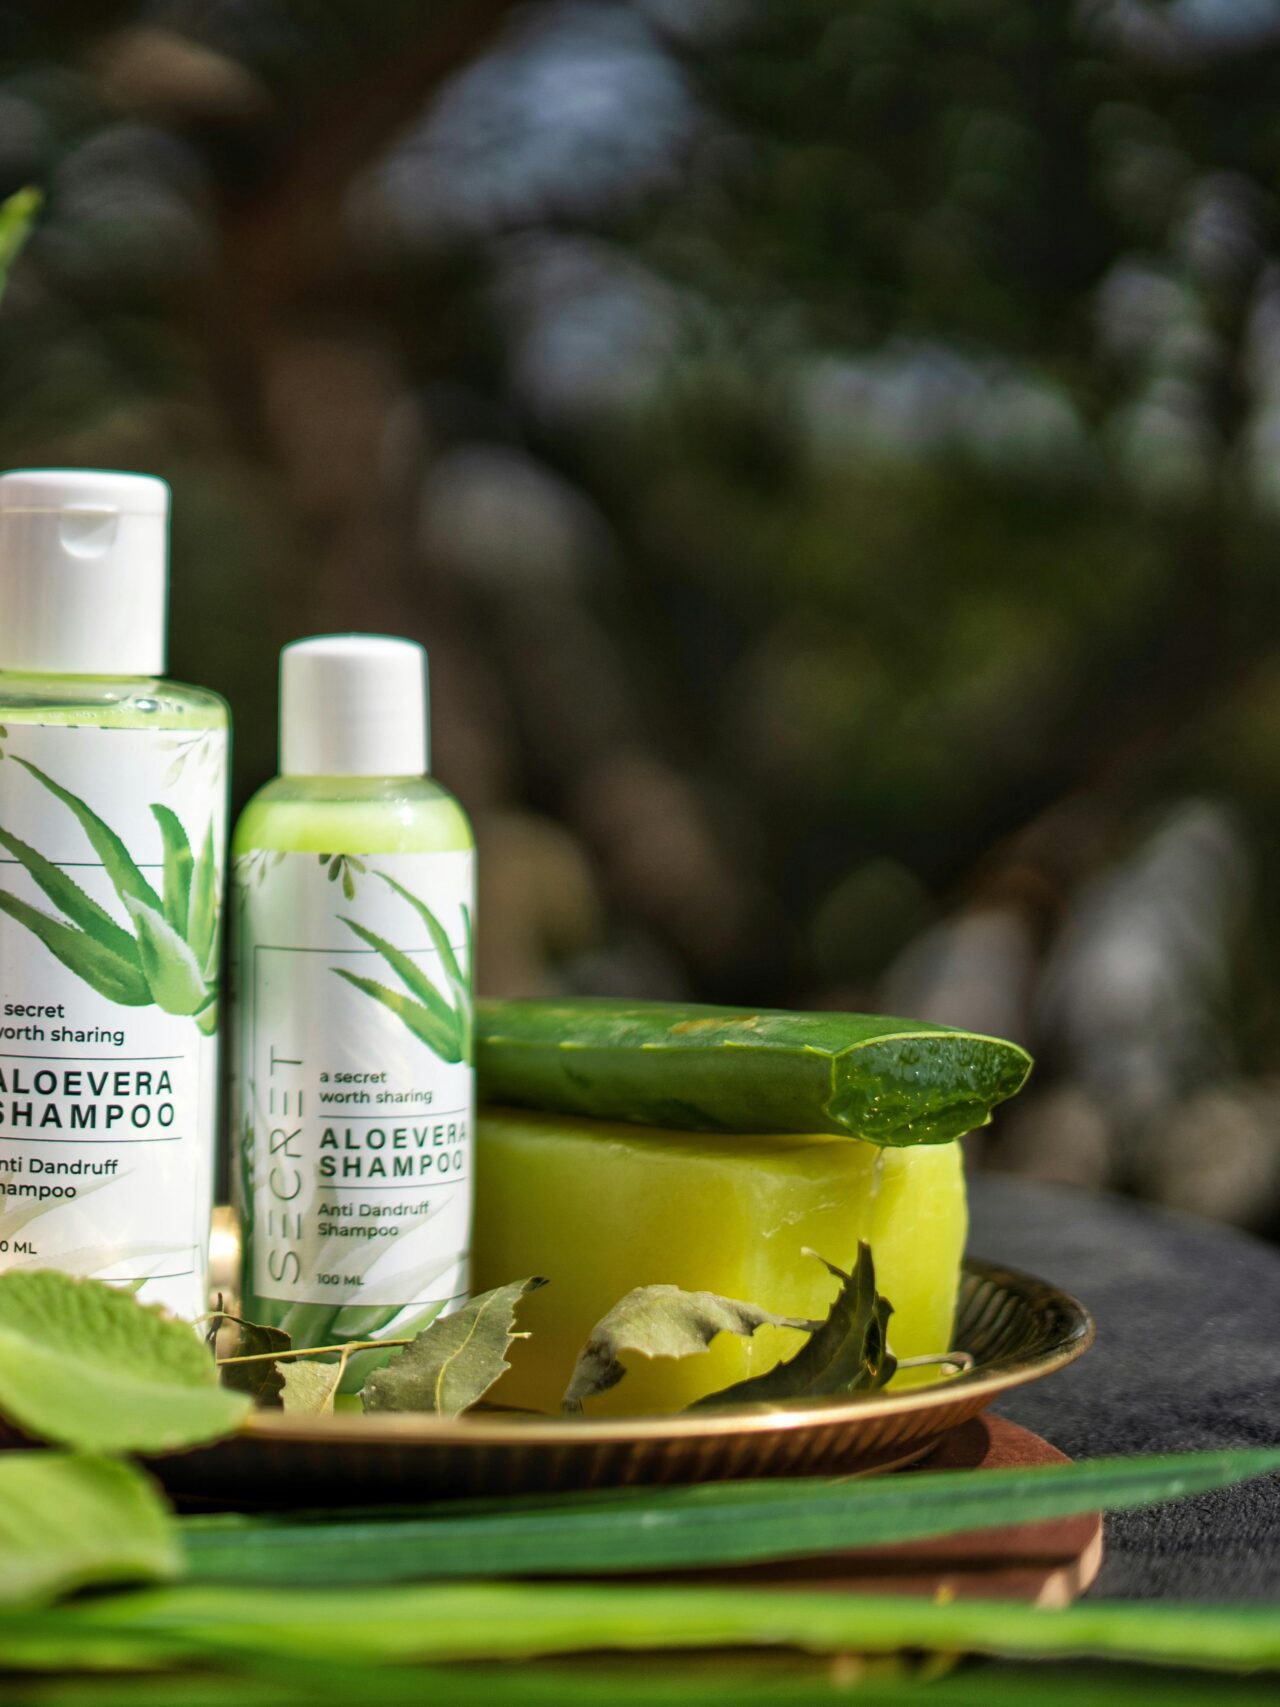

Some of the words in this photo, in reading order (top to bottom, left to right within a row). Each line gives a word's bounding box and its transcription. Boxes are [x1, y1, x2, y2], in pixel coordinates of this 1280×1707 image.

[4, 1002, 65, 1018] secret
[51, 1027, 125, 1046] sharing
[320, 1072, 329, 1083] a
[334, 1071, 387, 1084] secret
[320, 1090, 370, 1104] worth
[375, 1089, 432, 1104] sharing
[320, 1122, 466, 1149] ALOEVERA
[29, 1158, 119, 1175] Dandruff
[269, 1046, 303, 1284] SECRET
[320, 1150, 463, 1177] SHAMPOO
[318, 1202, 353, 1217] Anti
[359, 1200, 430, 1217] Dandruff
[318, 1222, 399, 1240] Shampoo
[13, 1242, 37, 1255] ML
[317, 1273, 340, 1286] 100
[344, 1275, 365, 1286] ML
